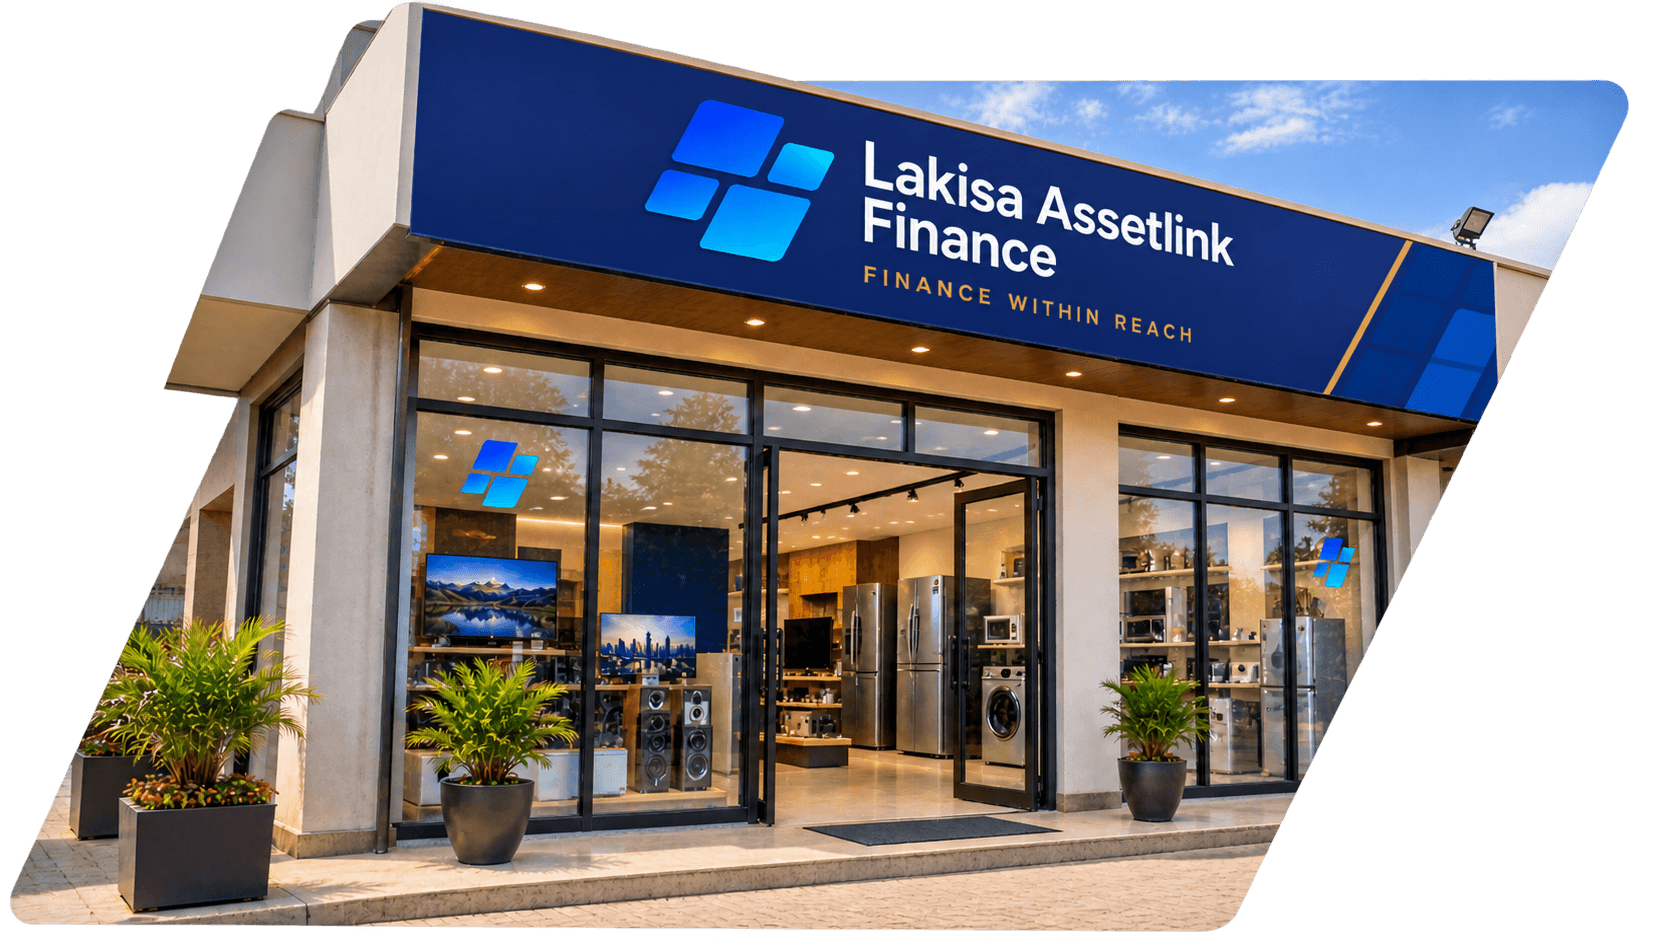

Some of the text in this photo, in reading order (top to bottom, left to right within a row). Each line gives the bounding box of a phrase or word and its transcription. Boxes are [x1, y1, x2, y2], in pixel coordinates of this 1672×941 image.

[864, 139, 1235, 267] Lakisa Assetlink
[864, 196, 1057, 278] Finance
[863, 265, 1193, 343] FINANCE WITHIN REACH
